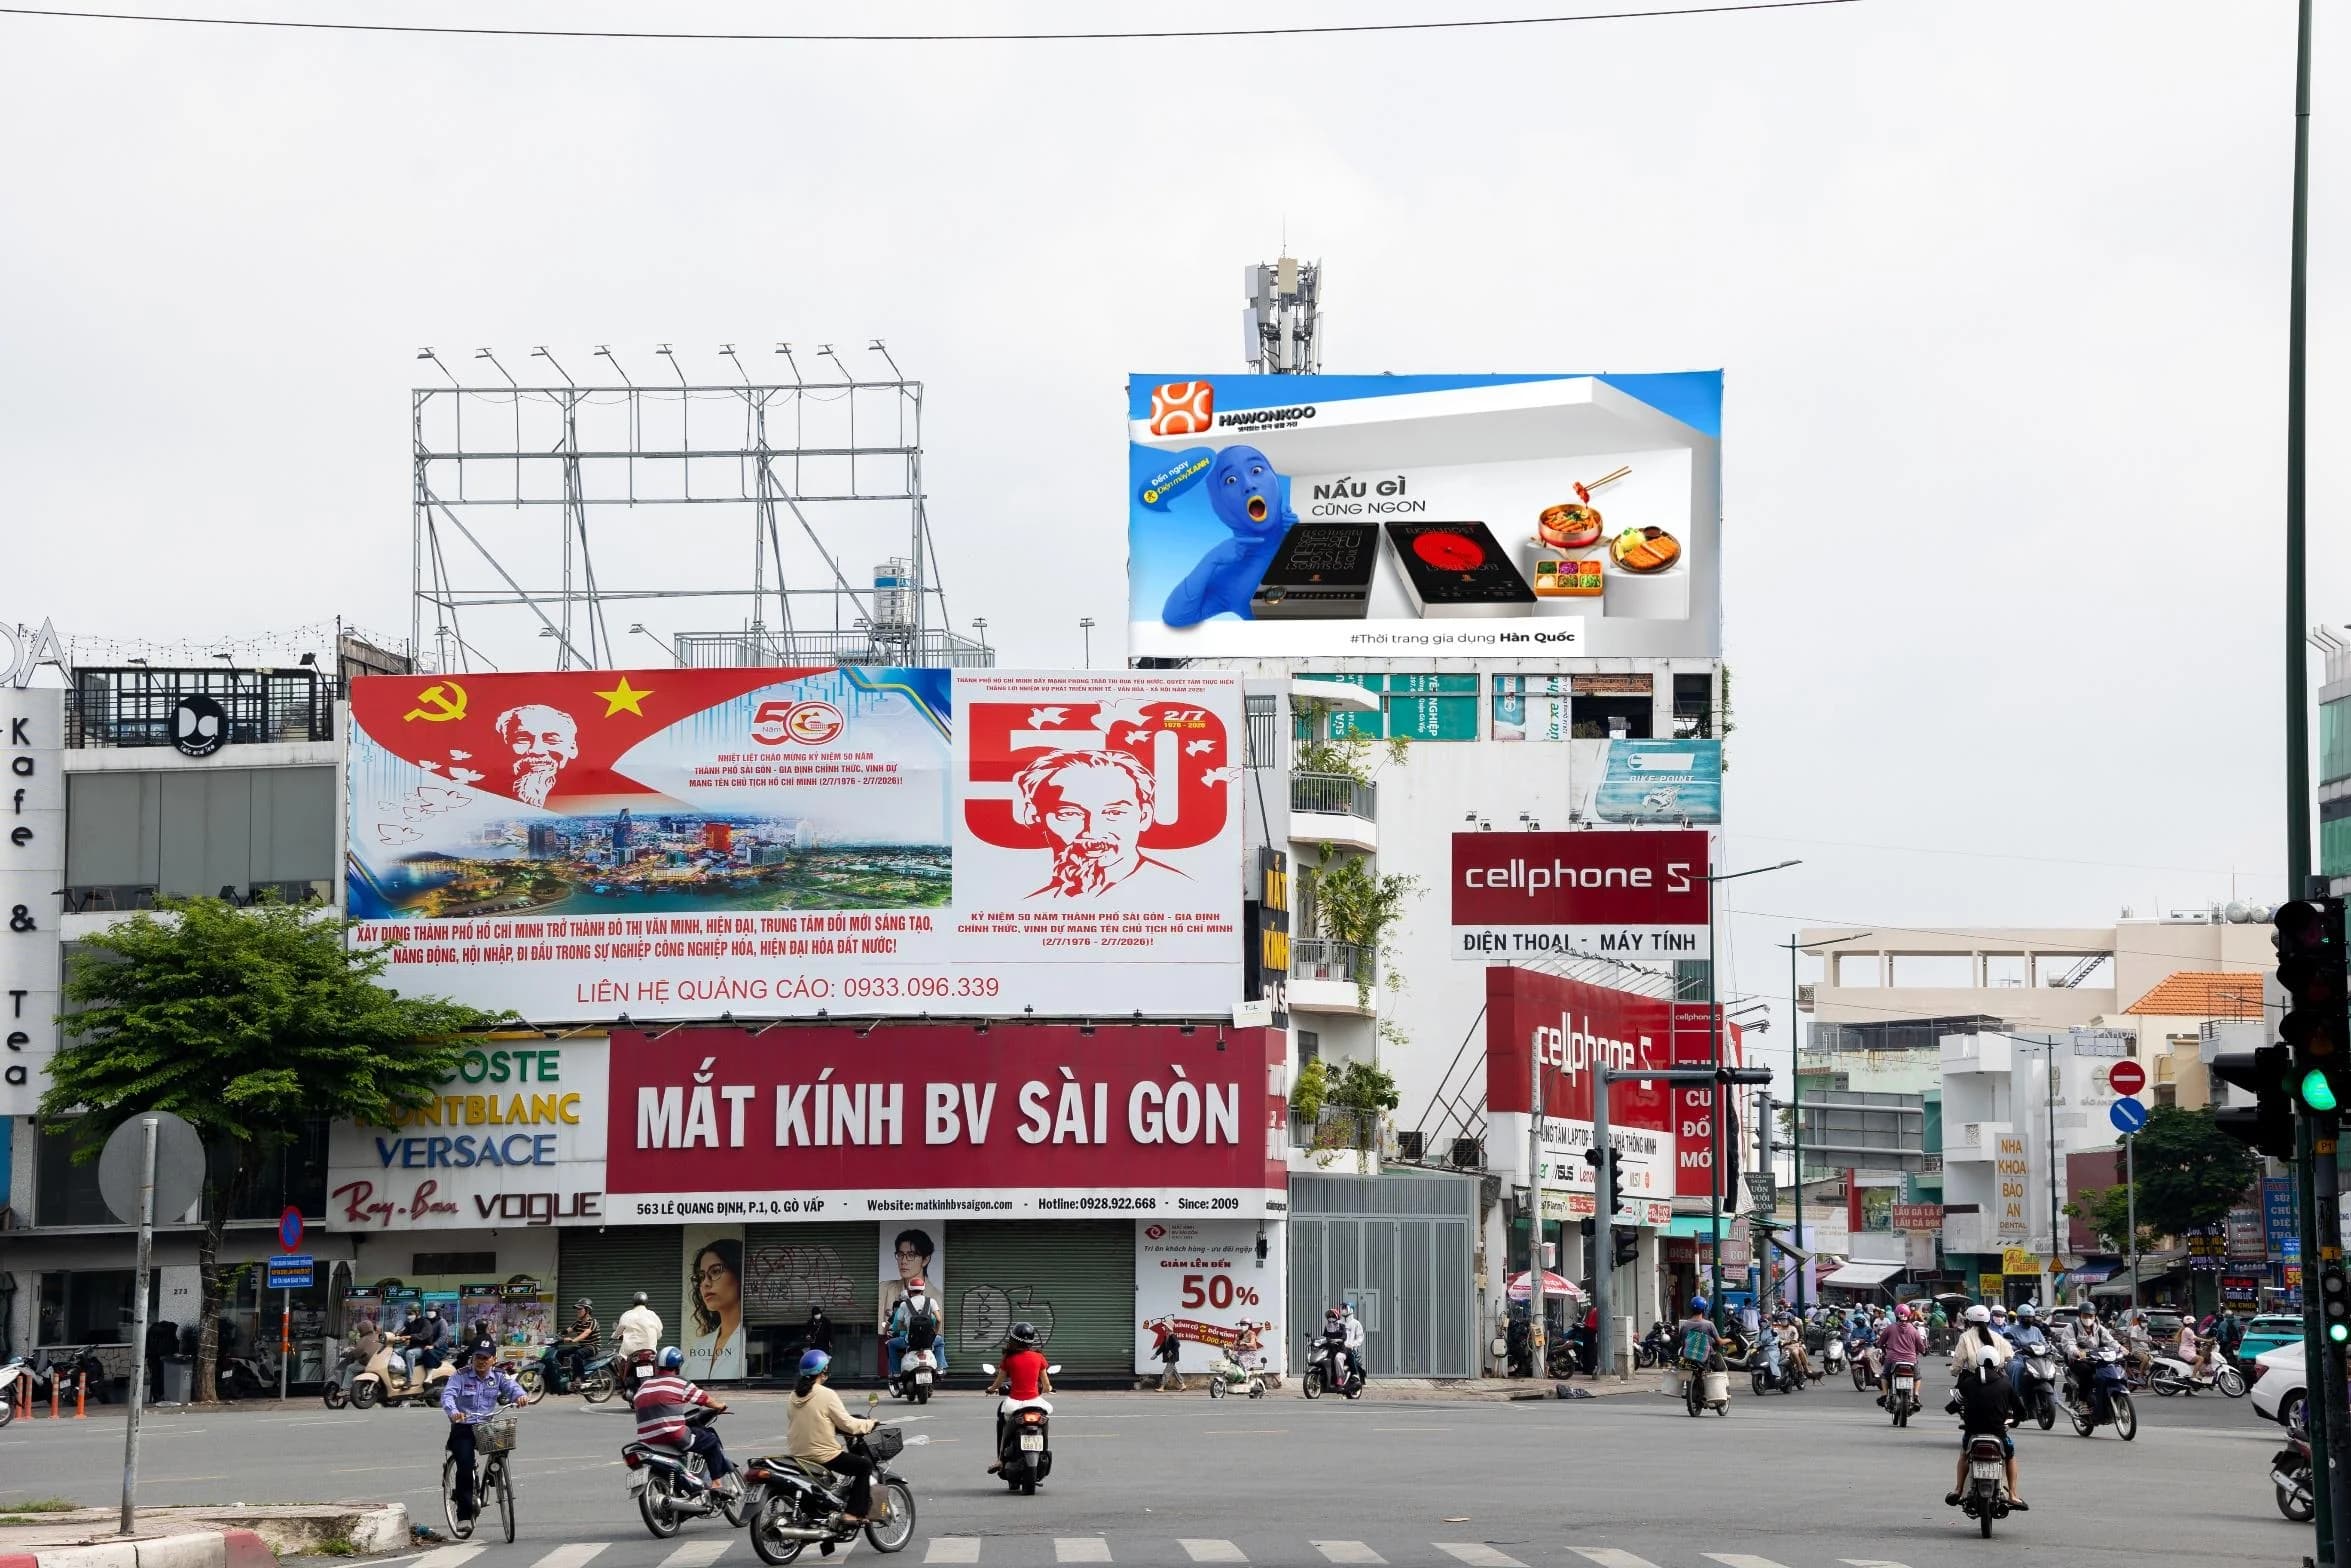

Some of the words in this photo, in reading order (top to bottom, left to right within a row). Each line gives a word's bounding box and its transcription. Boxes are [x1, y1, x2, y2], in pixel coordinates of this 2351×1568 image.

[1219, 406, 1316, 426] HAWONKOO
[1314, 476, 1366, 500] NẤU
[1376, 475, 1405, 496] GÌ
[1312, 503, 1362, 516] CŨNG
[1368, 501, 1425, 514] NGON
[1351, 634, 1387, 643] #Thời
[1392, 635, 1428, 644] trang
[1433, 636, 1453, 644] gia
[1458, 634, 1495, 644] dụng
[1500, 633, 1529, 642] Hàn
[1534, 631, 1575, 643] Quốc
[1164, 710, 1205, 721] 2/7
[1426, 697, 1440, 737] NGHIỆP
[11, 717, 34, 847] Kafe
[1465, 858, 1652, 896] cellphone
[1667, 863, 1691, 893] S
[10, 904, 38, 933] &
[357, 926, 379, 942] XÂY
[414, 925, 450, 941] THÀNH
[451, 924, 474, 940] PHỐ
[476, 923, 492, 940] HỒ
[493, 924, 513, 939] CHÍ
[514, 923, 545, 938] MINH
[546, 921, 567, 938] TRỞ
[569, 921, 606, 936] THÀNH
[607, 920, 624, 936] ĐÔ
[626, 920, 644, 935] THỊ
[646, 919, 669, 935] VĂN
[670, 919, 702, 934] MINH,
[706, 917, 733, 934] HIỆN
[735, 918, 755, 934] ĐẠI,
[761, 917, 798, 933] TRUNG
[800, 916, 826, 932] TÂM
[827, 914, 848, 932] ĐỔI
[849, 913, 872, 932] MỚI
[874, 915, 906, 932] SÁNG
[908, 914, 932, 932] TẠO,
[1101, 937, 1152, 945] 2/7/2026)!
[1263, 921, 1289, 971] KÍNH
[1464, 931, 1506, 954] ĐIỆN
[1513, 934, 1571, 951] THOẠI
[1601, 930, 1643, 950] MÁY
[1651, 930, 1695, 950] TÍNH
[577, 979, 629, 1004] LIÊN
[638, 979, 670, 1004] HỆ
[677, 976, 769, 1001] QUẢNG
[775, 974, 836, 999] CÁO:
[844, 977, 999, 996] 0933.096.339
[5, 990, 30, 1085] Tea
[1537, 1011, 1635, 1088] cellphone
[638, 1057, 755, 1148] MẮT
[776, 1068, 903, 1146] KÍNH
[926, 1083, 997, 1144] BV
[1017, 1066, 1107, 1143] SÀI
[1129, 1064, 1238, 1143] GÒN
[375, 1133, 558, 1169] VERSACE
[1644, 1138, 1657, 1156] MINH
[2001, 1139, 2022, 1154] NHA
[1680, 1148, 1713, 1168] MỚ
[1998, 1160, 2027, 1175] KHOA
[2003, 1178, 2023, 1198] BẢO
[637, 1203, 658, 1215] 563
[662, 1201, 674, 1214] LÊ
[677, 1202, 713, 1216] QUANG
[717, 1202, 746, 1215] ĐỊNH,
[749, 1202, 767, 1214] P.1,
[771, 1201, 781, 1214] Q.
[784, 1198, 799, 1212] GÒ
[804, 1197, 824, 1212] VẤP
[868, 1200, 913, 1211] Website:
[916, 1199, 1012, 1211] matkinhbvsaigon.com
[1039, 1198, 1078, 1209] Hotline:
[1080, 1198, 1156, 1209] 0928.922.668
[1178, 1198, 1209, 1209] Since:
[1211, 1198, 1238, 1209] 2009
[2006, 1204, 2021, 1218] AN
[2000, 1221, 2027, 1229] DENTAL
[1160, 1259, 1187, 1267] GIẢM
[1190, 1258, 1208, 1267] LÊN
[1210, 1258, 1231, 1268] ĐẾN
[1181, 1274, 1259, 1309] 50%
[689, 1346, 732, 1357] BOLON
